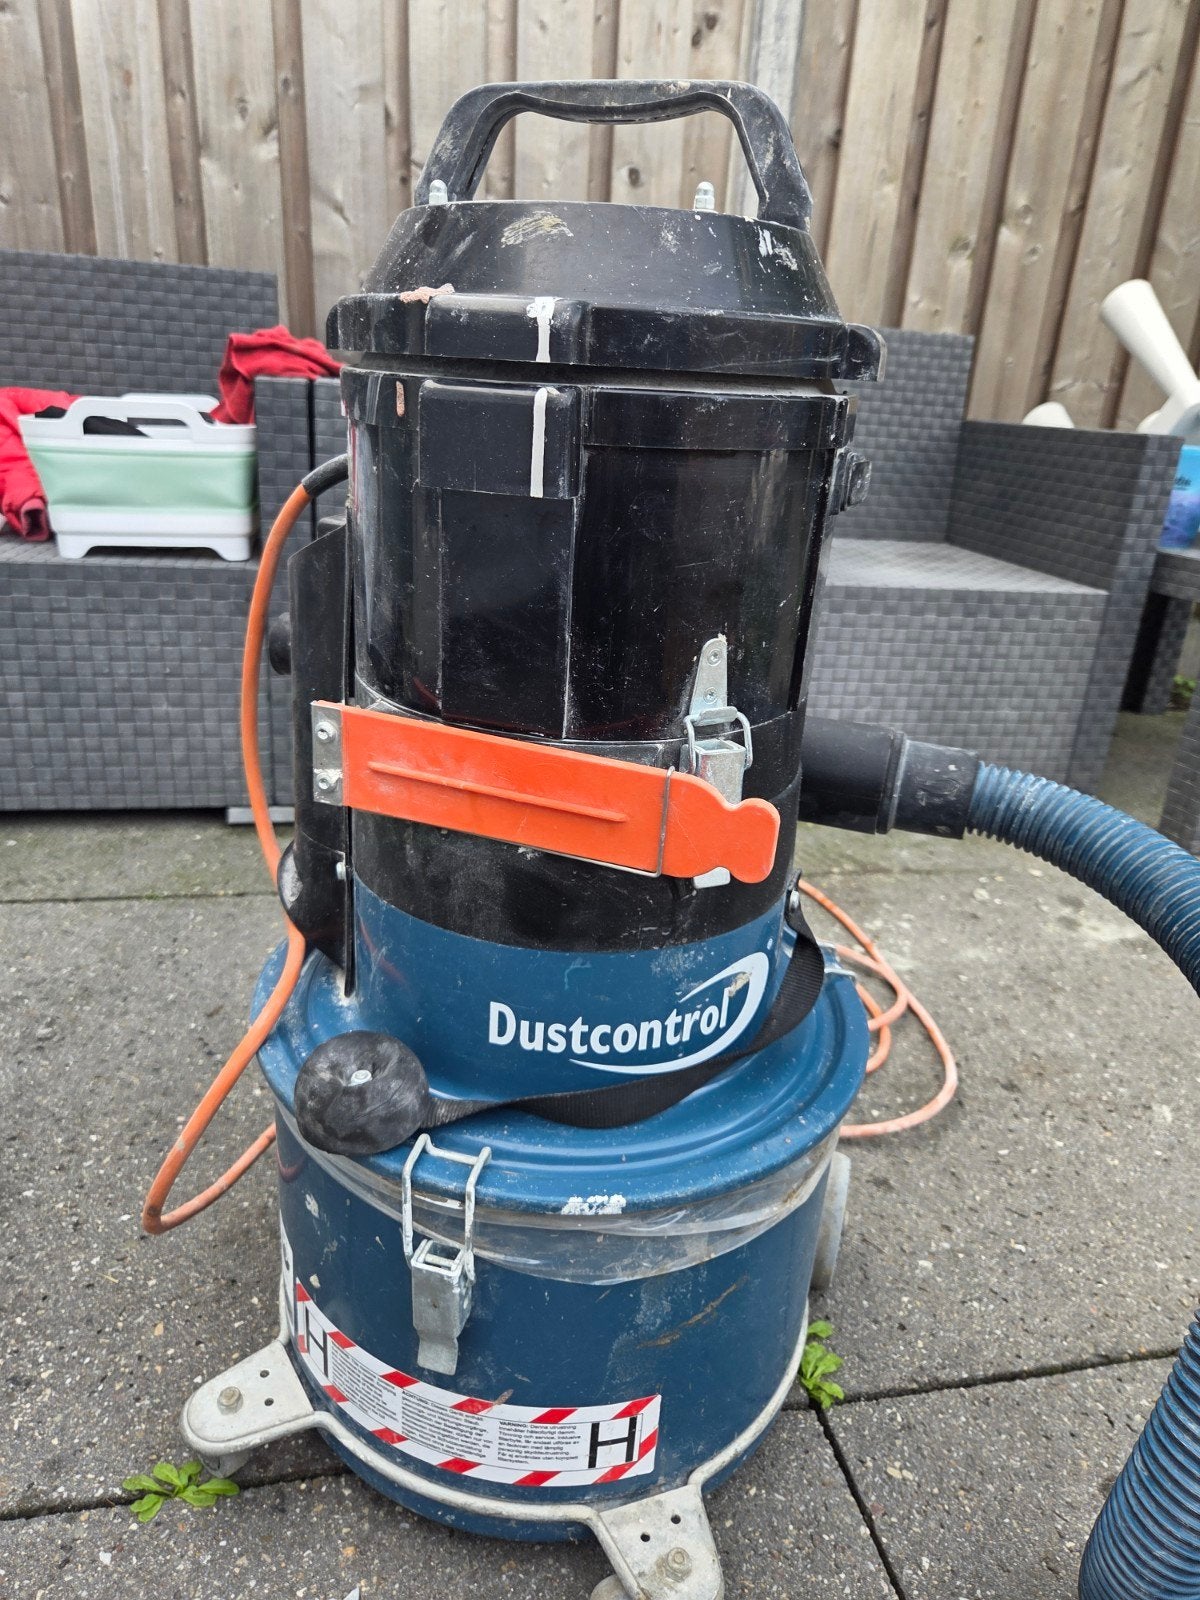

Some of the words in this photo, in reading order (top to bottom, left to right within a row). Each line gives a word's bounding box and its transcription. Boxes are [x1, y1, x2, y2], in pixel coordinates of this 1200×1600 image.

[489, 987, 729, 1054] Dustcontrol
[305, 1305, 328, 1378] H
[588, 1416, 637, 1469] H
